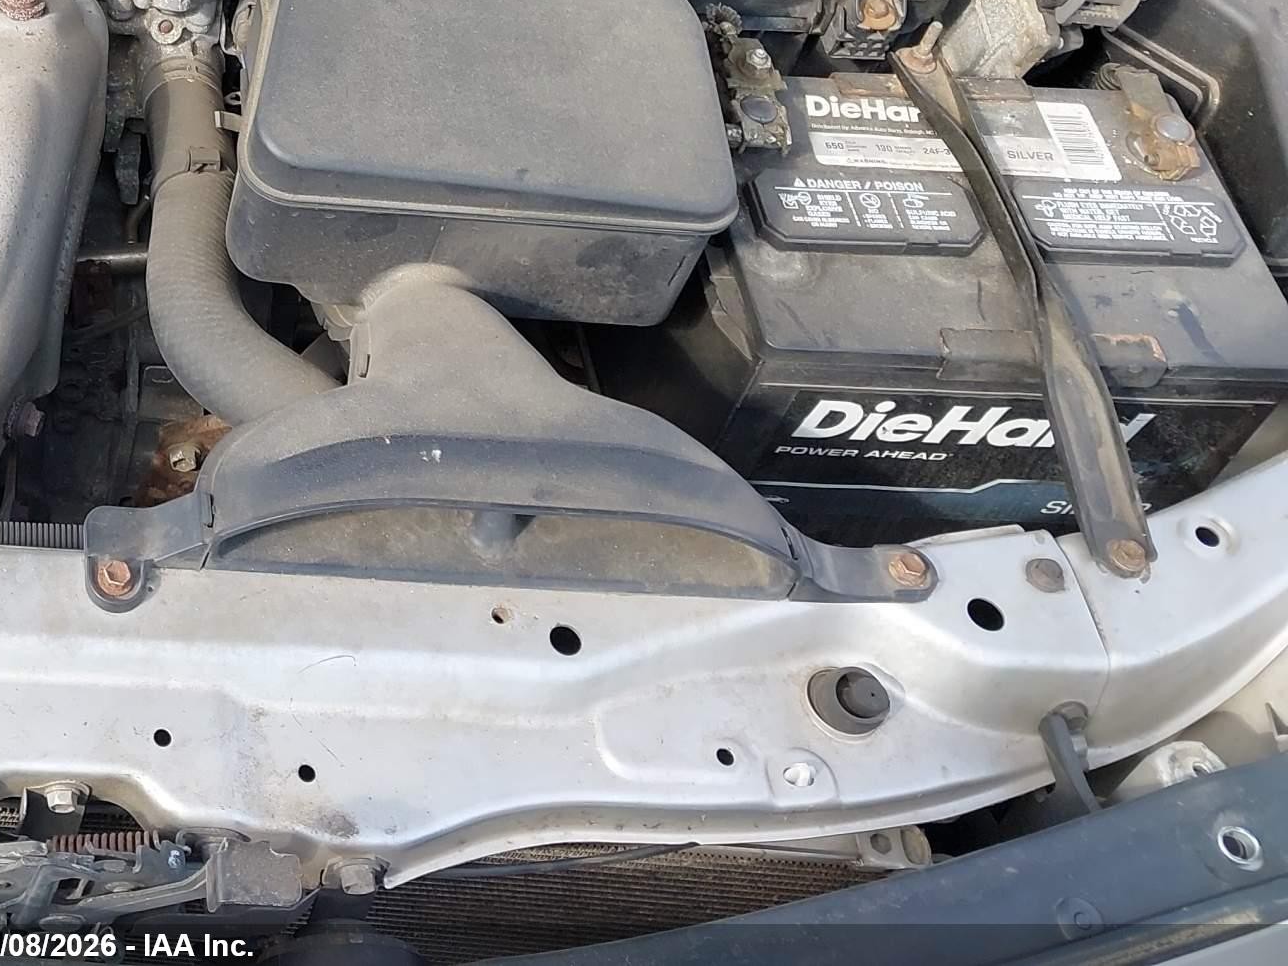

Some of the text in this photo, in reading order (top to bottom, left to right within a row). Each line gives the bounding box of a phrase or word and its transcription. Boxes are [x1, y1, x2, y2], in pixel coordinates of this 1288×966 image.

[805, 94, 921, 123] DieHar
[1007, 150, 1054, 161] SILVER
[806, 178, 861, 190] DANGER
[874, 181, 924, 192] POISON
[775, 446, 948, 462] POWER AHEAD
